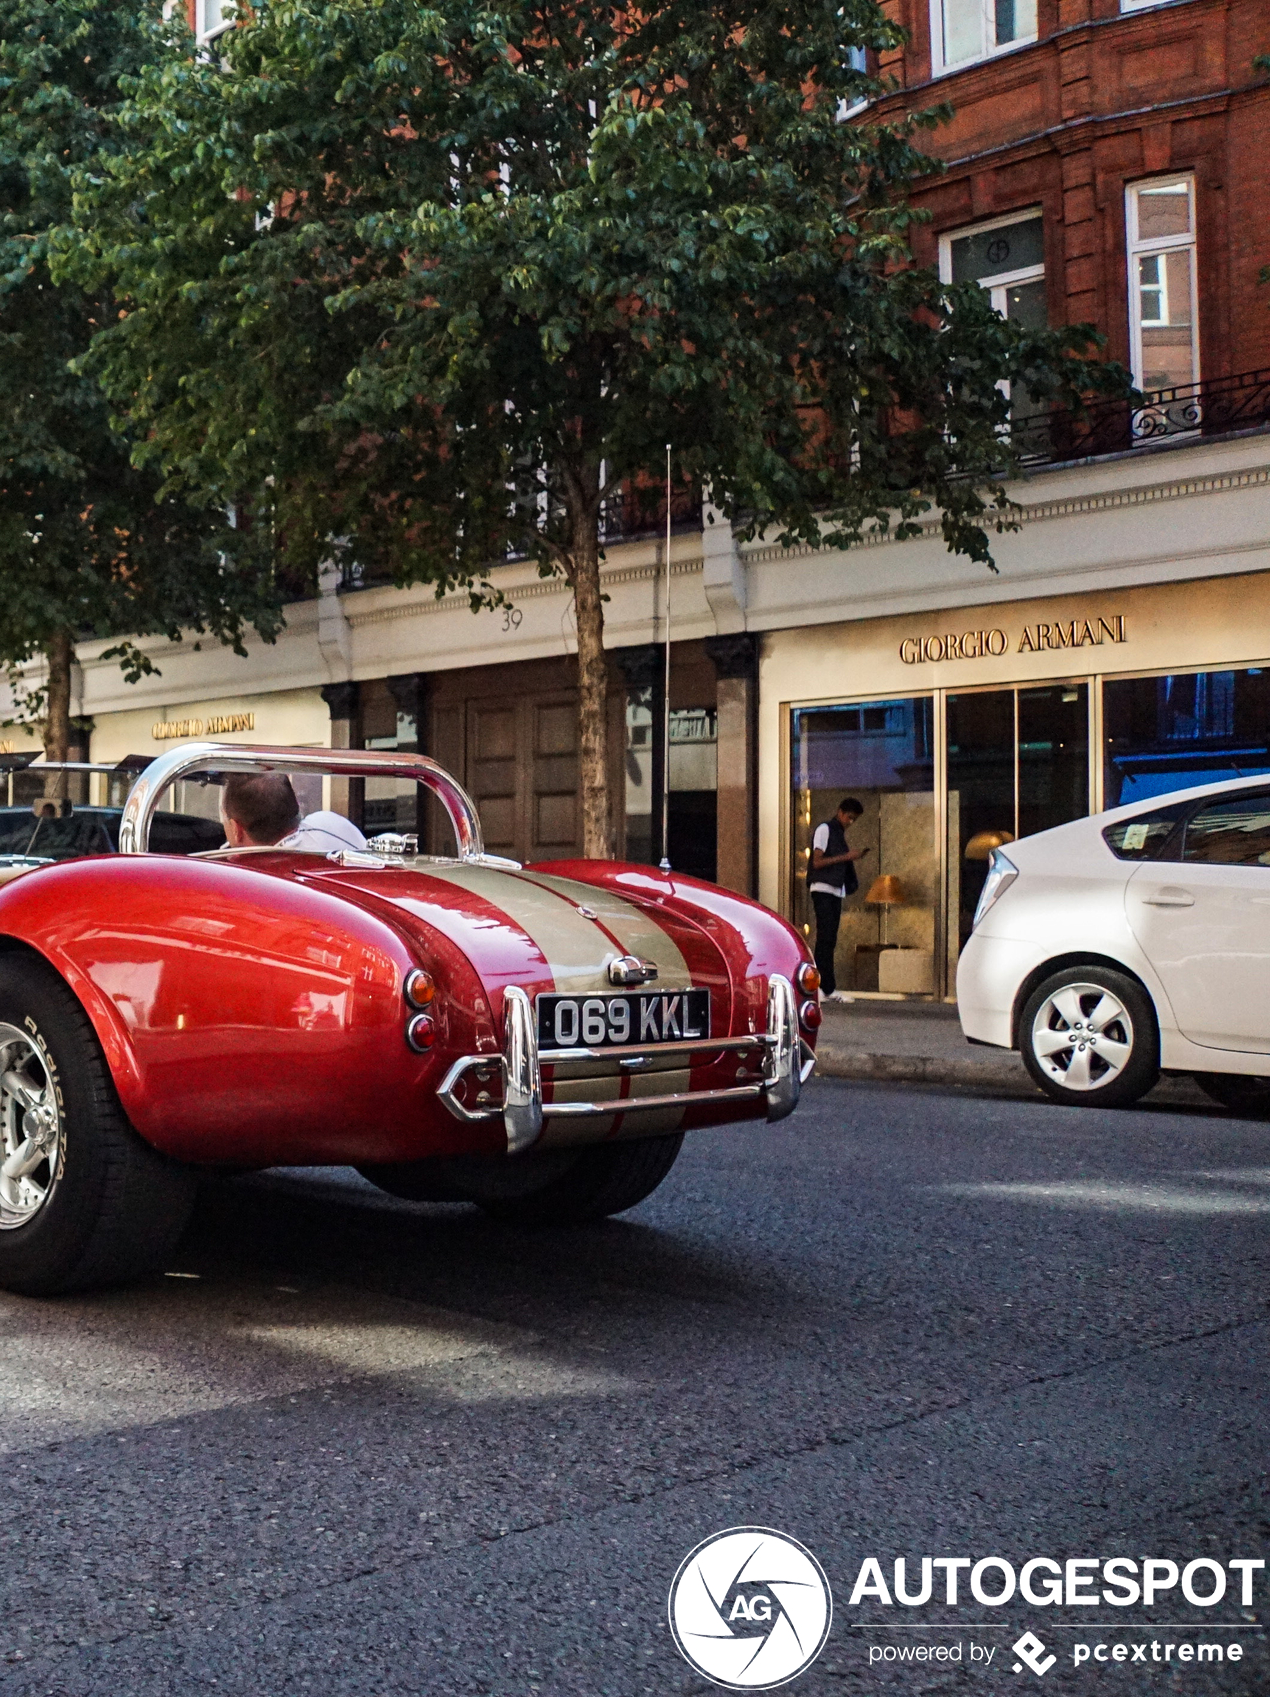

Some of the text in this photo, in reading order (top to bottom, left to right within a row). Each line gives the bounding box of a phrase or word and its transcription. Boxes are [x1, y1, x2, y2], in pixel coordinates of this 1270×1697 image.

[502, 609, 523, 632] 39
[900, 615, 1128, 664] GIORGIO ARMANI
[152, 712, 254, 740] GIORGIO ARMANI
[640, 995, 701, 1041] KKL
